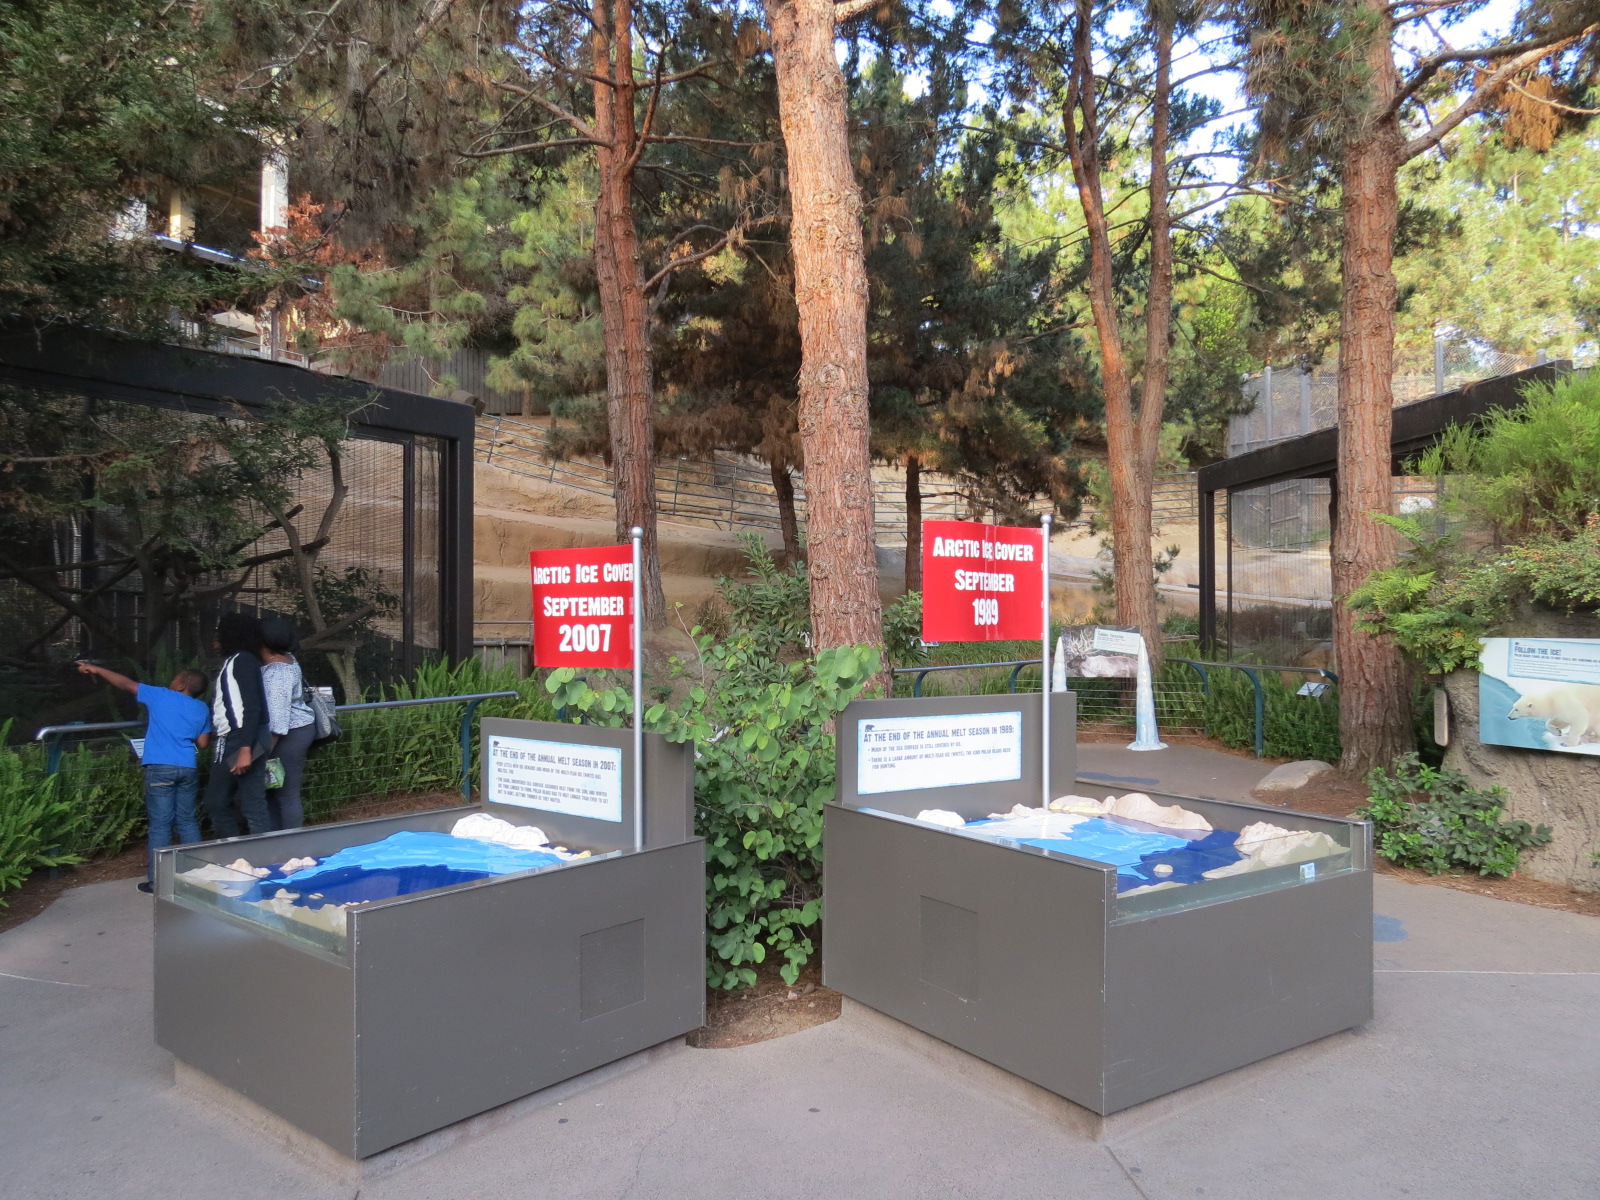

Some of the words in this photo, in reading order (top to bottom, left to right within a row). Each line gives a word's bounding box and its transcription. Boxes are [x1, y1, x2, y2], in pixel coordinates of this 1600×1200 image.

[932, 536, 980, 558] ARCTIC
[994, 541, 1034, 562] COVER
[533, 566, 571, 585] ARCTIC
[575, 563, 599, 583] ICE
[954, 569, 1015, 592] SEPTEMBER
[543, 596, 624, 617] SEPTEMBER
[972, 598, 999, 626] 1989
[558, 623, 612, 652] 2007
[864, 734, 872, 742] AT
[874, 733, 886, 742] THE
[889, 732, 900, 741] END
[903, 732, 910, 740] OF
[913, 731, 924, 739] THE
[927, 729, 949, 738] ANNUAL
[952, 728, 966, 737] MELT
[968, 727, 990, 736] SEASON
[992, 726, 997, 734] IN
[1000, 725, 1014, 734] 1989:
[493, 749, 498, 757] AT
[510, 751, 518, 759] END
[520, 752, 525, 760] OF
[538, 754, 556, 764] ANNUAL
[558, 756, 570, 765] MELT
[572, 758, 591, 768] SEASON
[593, 760, 598, 768] IN
[600, 761, 616, 771] 2007:
